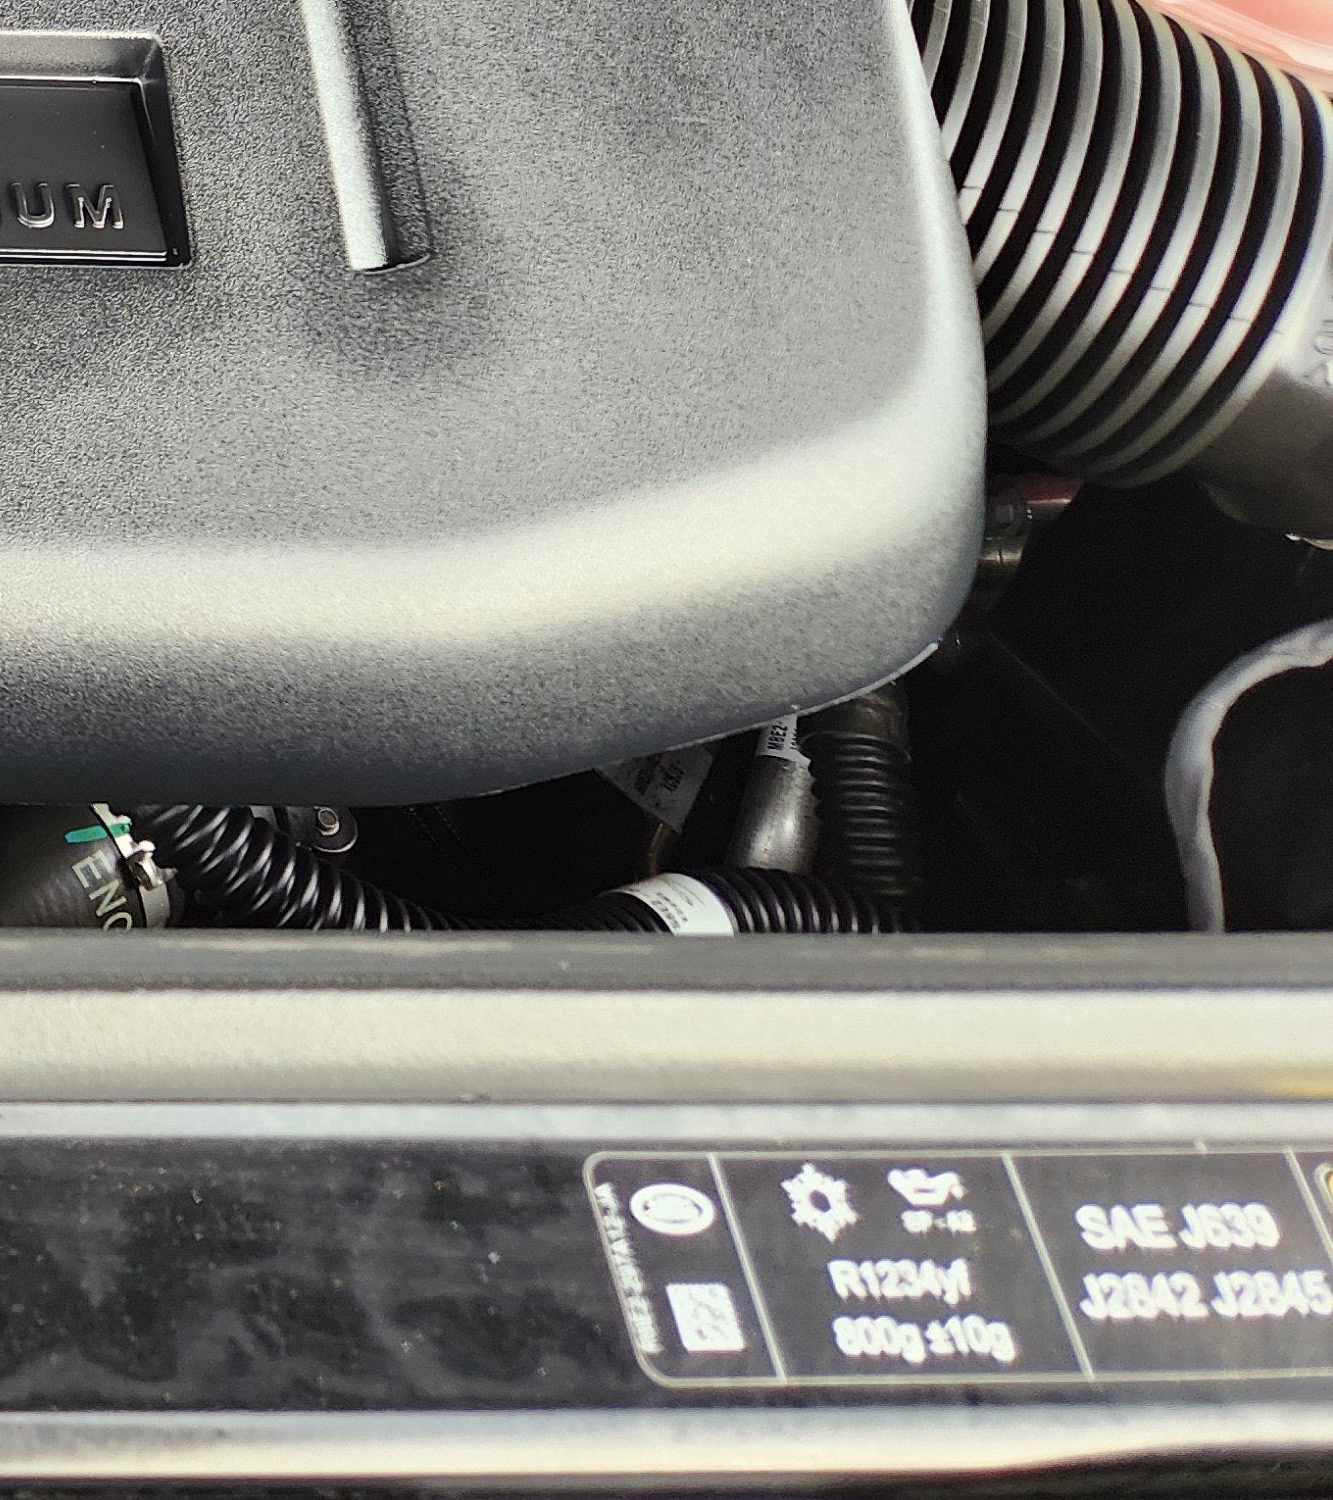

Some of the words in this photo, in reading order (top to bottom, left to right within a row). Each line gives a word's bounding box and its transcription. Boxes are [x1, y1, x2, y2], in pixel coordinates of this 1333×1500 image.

[1075, 1203, 1178, 1250] SAE
[1178, 1203, 1281, 1249] J639
[827, 1257, 973, 1307] R1234yf
[1079, 1272, 1210, 1320] J2842
[832, 1315, 927, 1366] 800g
[925, 1313, 1017, 1365] ±10g
